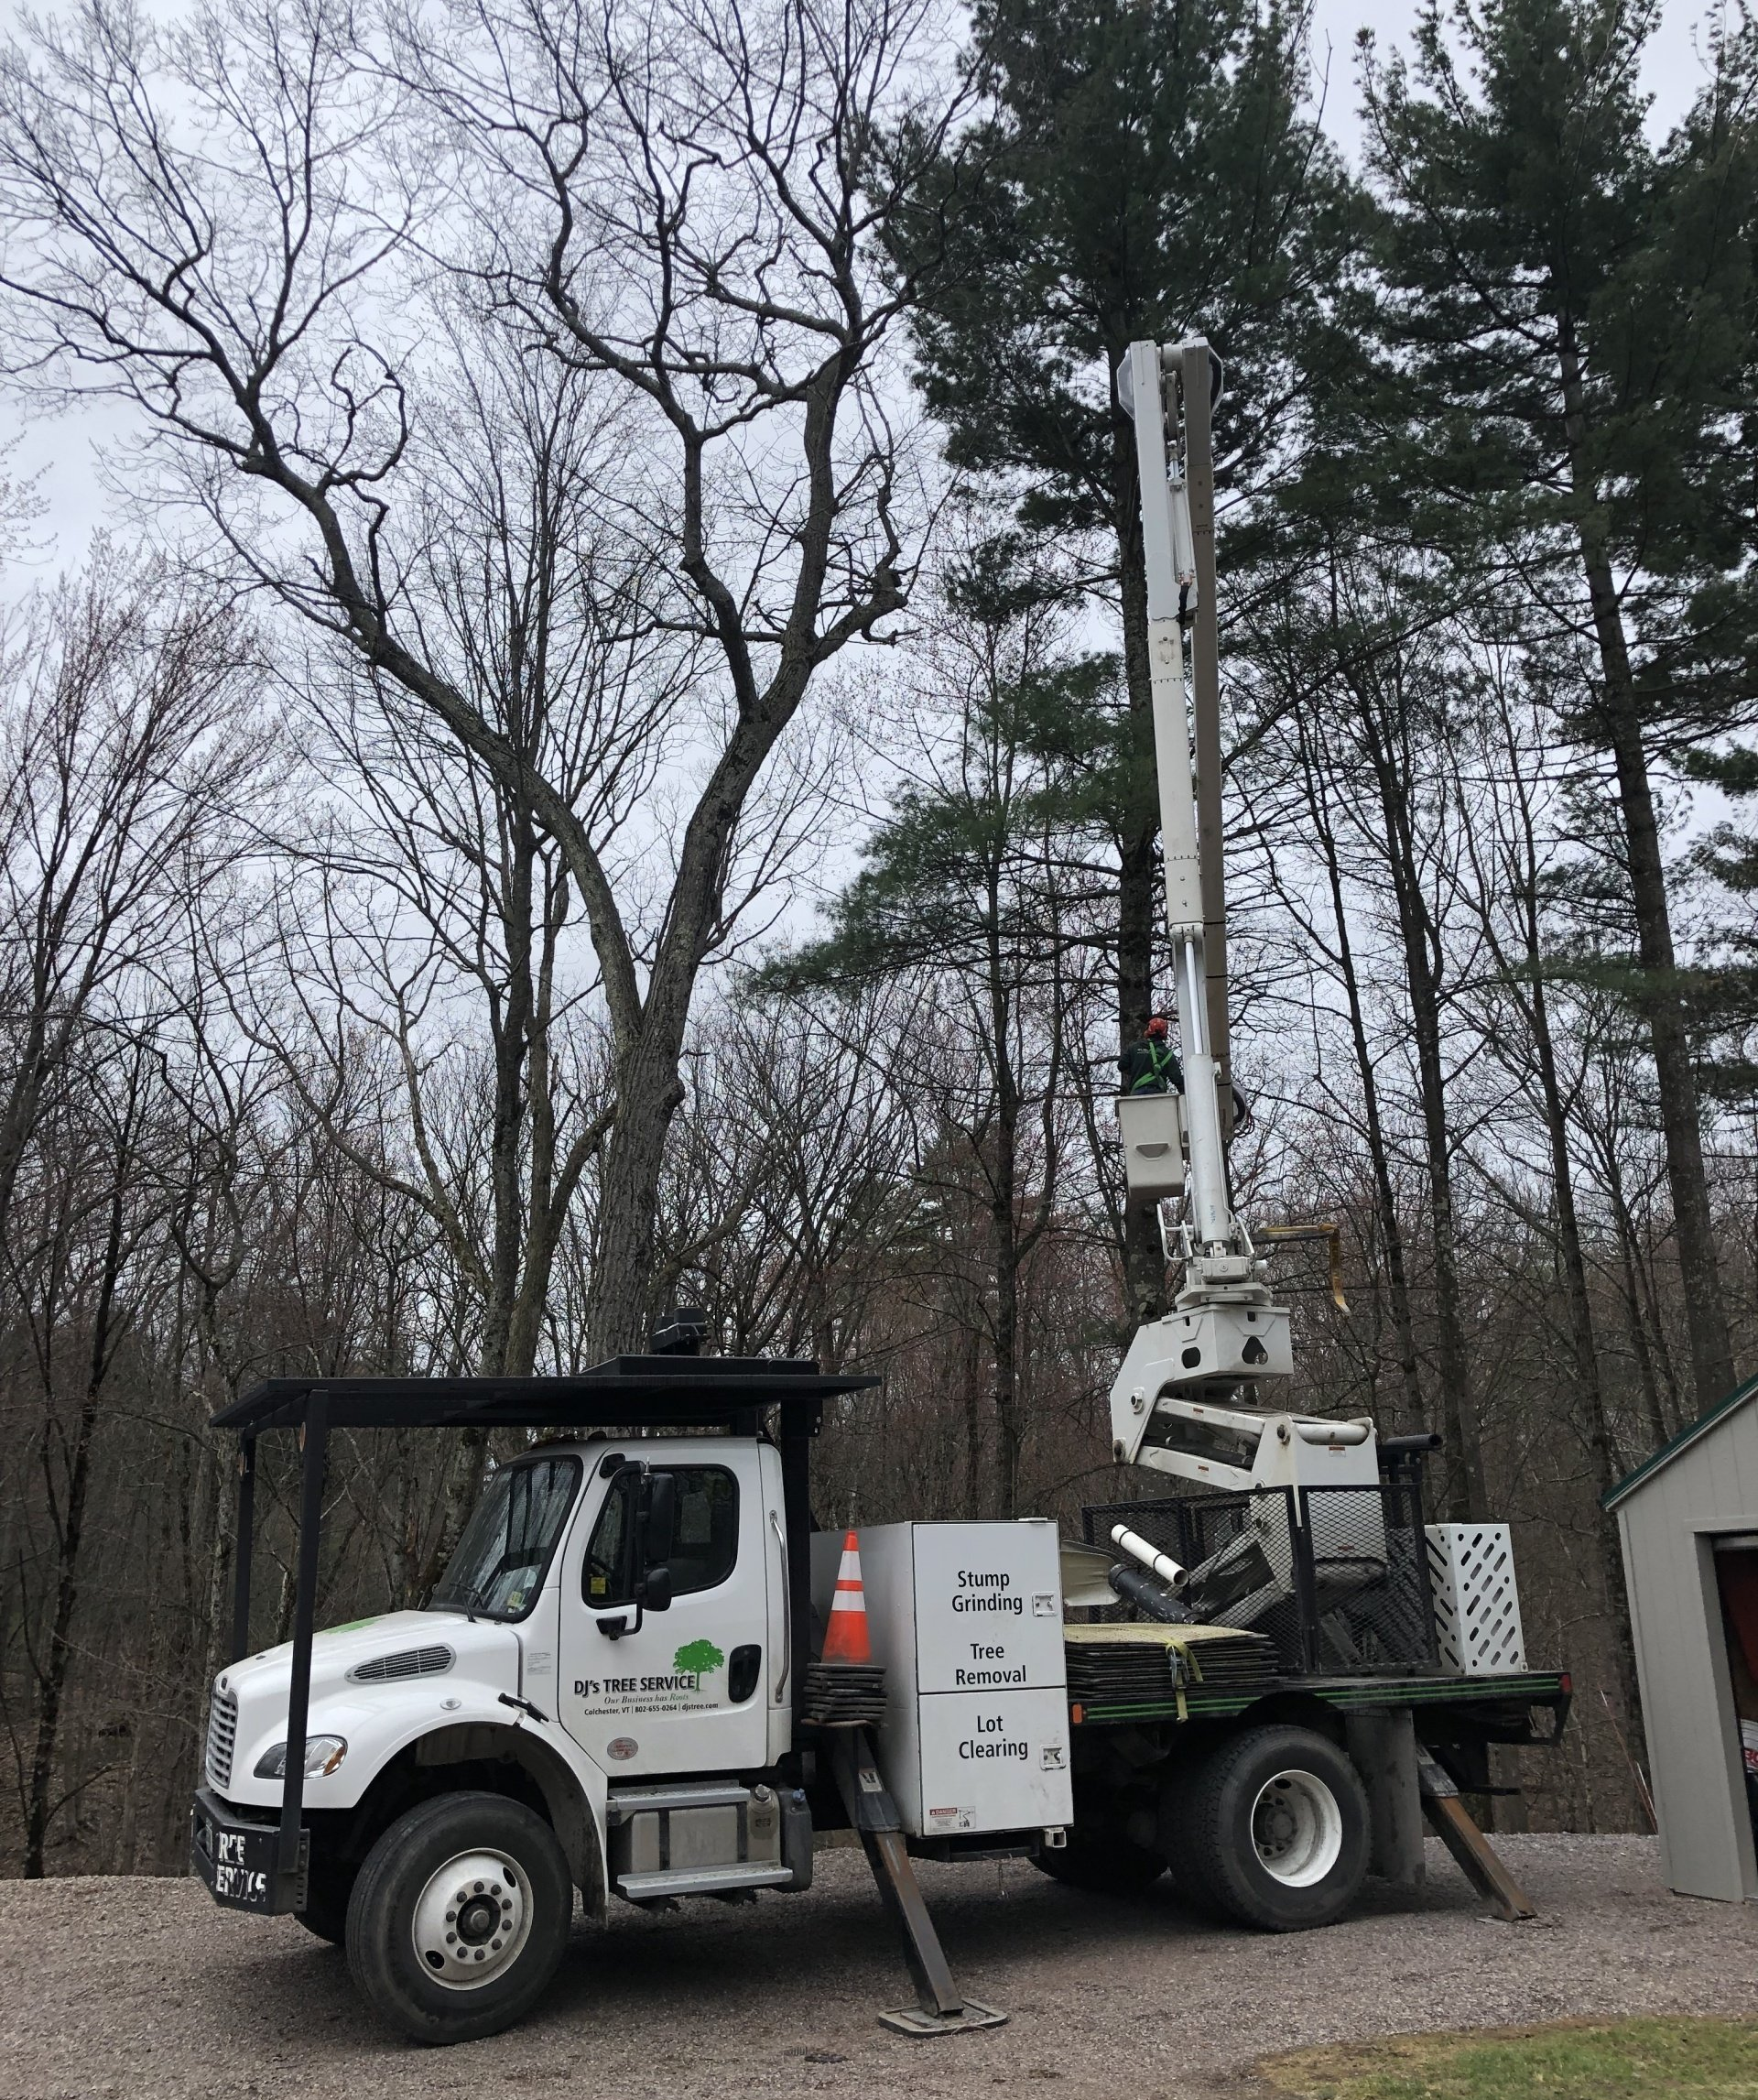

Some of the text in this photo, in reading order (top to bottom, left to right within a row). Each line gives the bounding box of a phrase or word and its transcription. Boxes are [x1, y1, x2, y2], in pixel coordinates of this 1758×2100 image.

[957, 1570, 1010, 1591] Stump
[951, 1593, 1023, 1615] Grinding
[970, 1643, 1004, 1659] Tree
[955, 1665, 1026, 1685] Removal
[573, 1674, 696, 1698] DJ's TREE SERVICE
[604, 1692, 689, 1704] Our Business has Roots
[584, 1706, 621, 1715] Colchester,
[635, 1704, 678, 1714] 802-655-0264
[681, 1703, 719, 1713] djstree.com
[977, 1714, 1004, 1733] Lot
[959, 1738, 1028, 1760] Clearing
